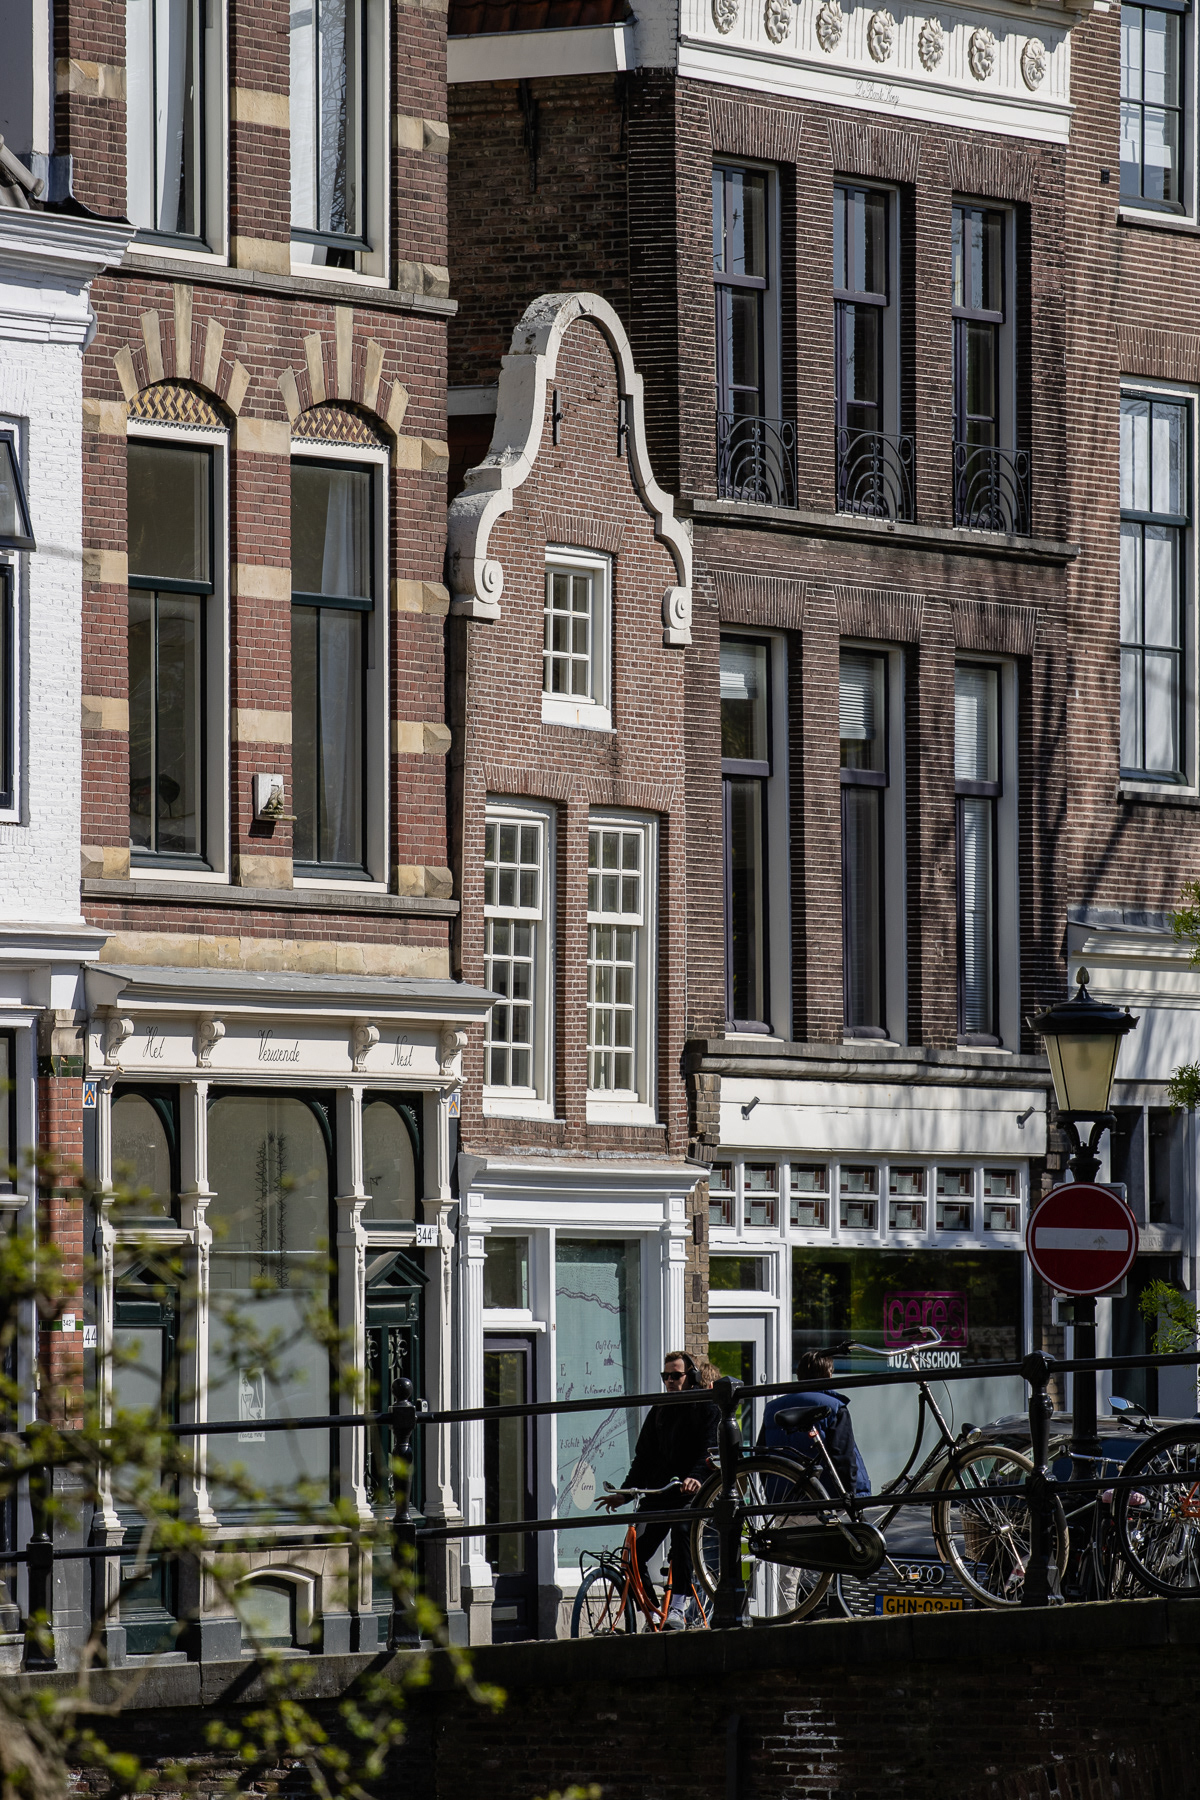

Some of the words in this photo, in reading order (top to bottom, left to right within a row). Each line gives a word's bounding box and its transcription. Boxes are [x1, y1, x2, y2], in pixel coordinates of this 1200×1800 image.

[143, 1026, 165, 1059] Het
[258, 1029, 300, 1063] Verwende
[391, 1035, 413, 1067] Nest
[888, 1300, 963, 1339] ceres
[581, 1482, 594, 1491] Ceres
